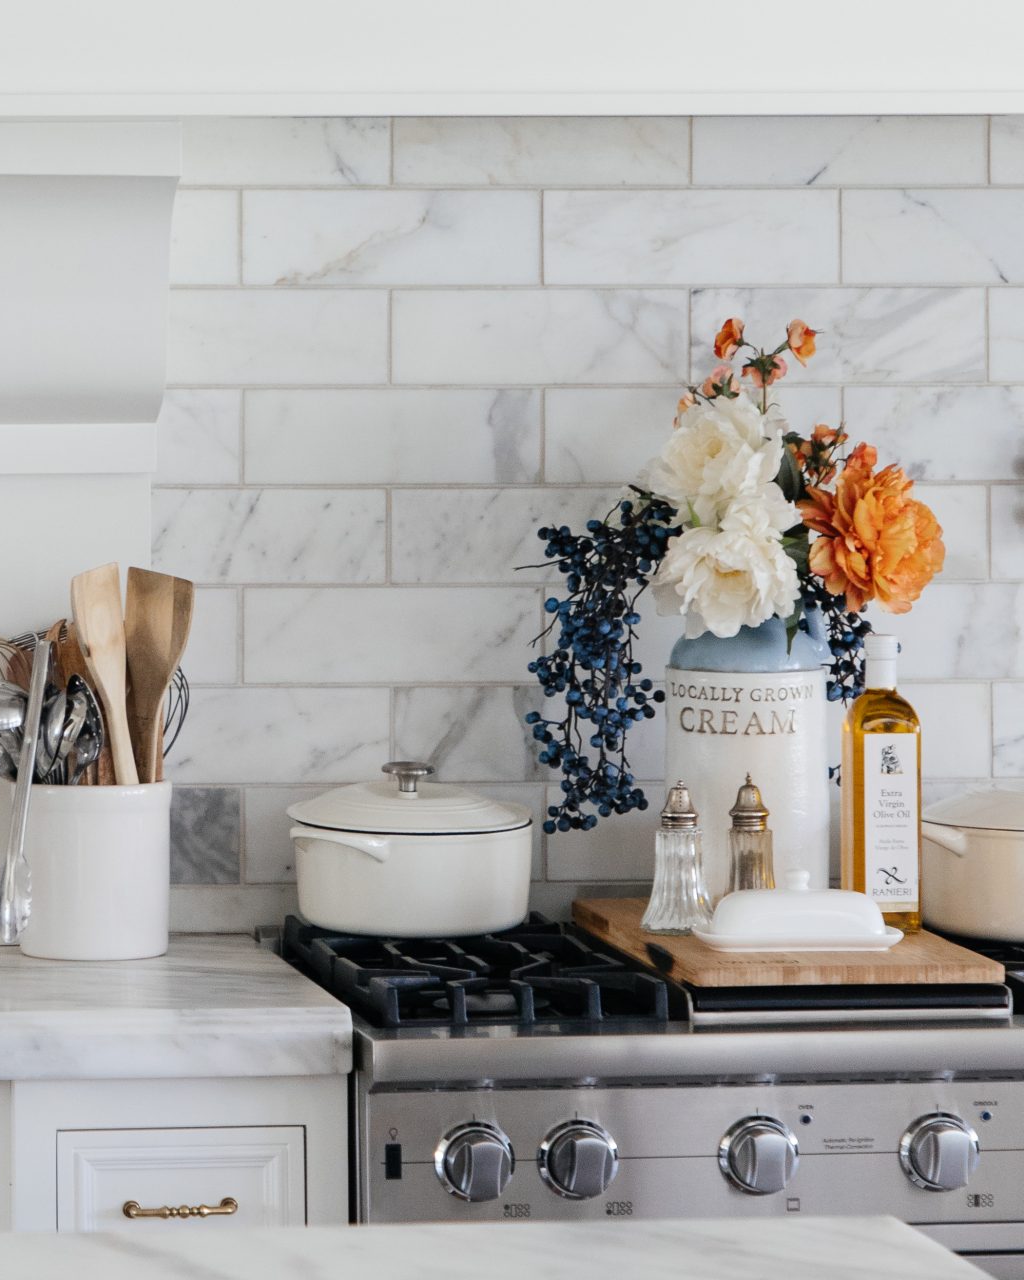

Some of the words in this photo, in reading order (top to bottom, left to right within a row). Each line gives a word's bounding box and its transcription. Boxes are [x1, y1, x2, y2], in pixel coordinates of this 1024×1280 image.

[670, 682, 743, 702] LOCALLY
[749, 684, 814, 702] GROWN
[679, 706, 796, 736] CREAM
[880, 789, 903, 797] Extra
[878, 799, 905, 809] Virgin
[873, 810, 894, 818] Olive
[896, 810, 911, 818] Oil
